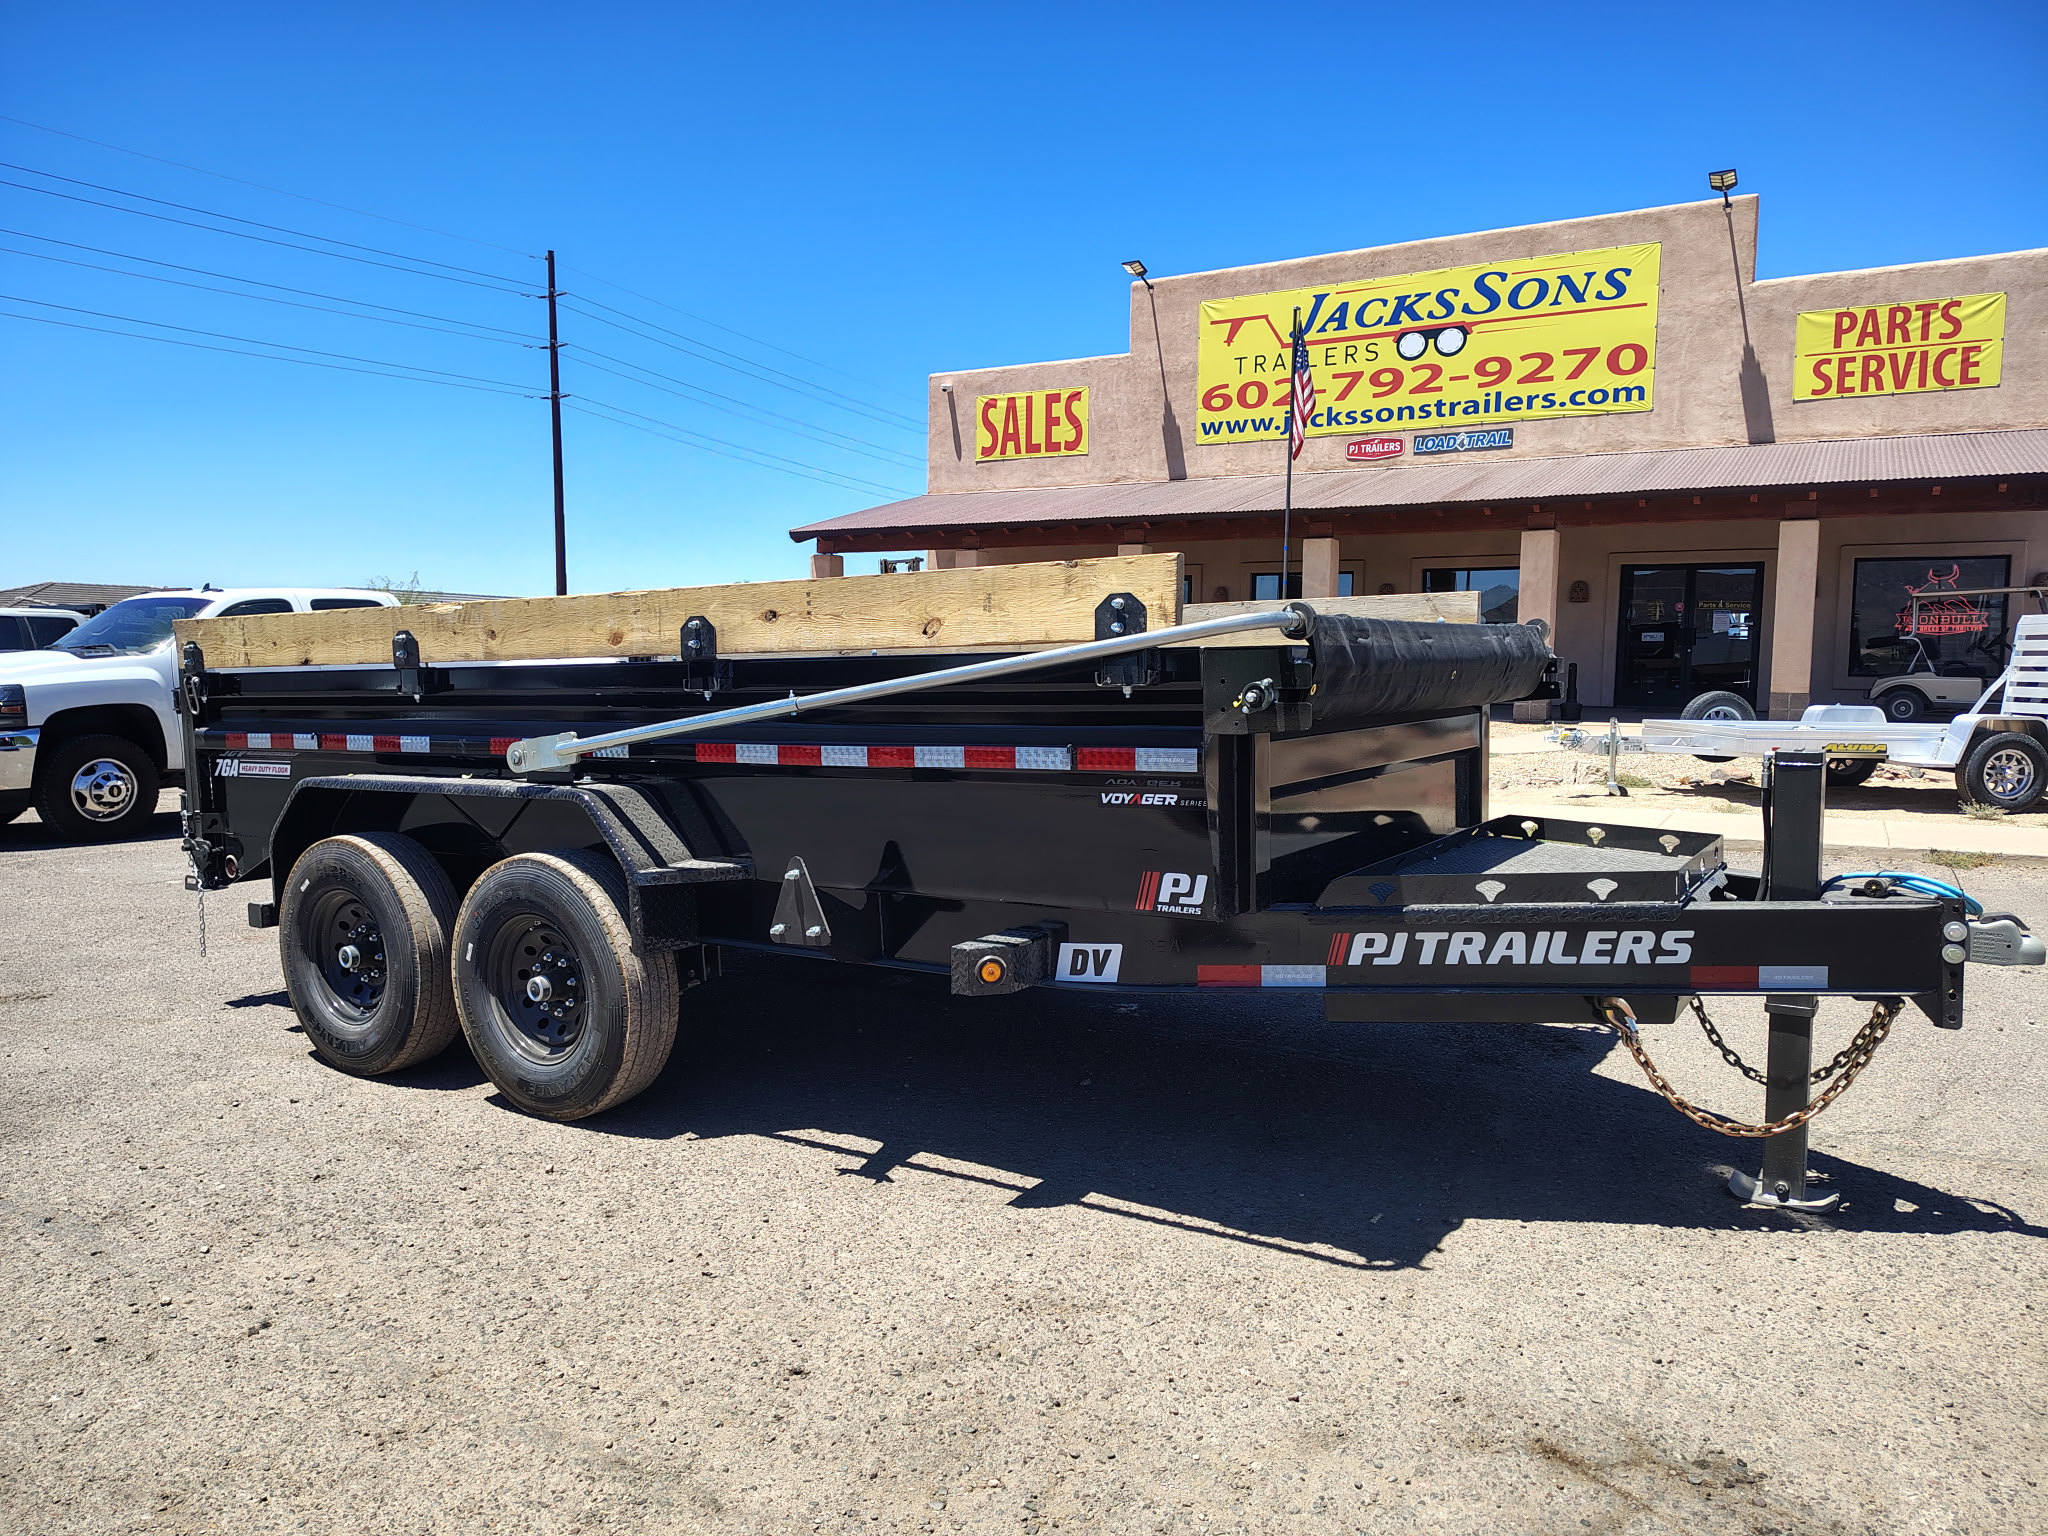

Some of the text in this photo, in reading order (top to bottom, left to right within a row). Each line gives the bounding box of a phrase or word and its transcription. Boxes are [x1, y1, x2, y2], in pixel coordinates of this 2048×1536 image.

[1833, 300, 1963, 349] PARTS
[1234, 343, 1379, 375] TRALERS
[1811, 346, 1982, 396] SERVICE
[1201, 343, 1648, 412] 602-792-9270
[981, 391, 1083, 457] SALES
[1201, 385, 1646, 436] www.jckssonstrailers.com
[1349, 441, 1401, 454] PJ TRAILERS
[1823, 743, 1887, 753] ALUMA
[214, 758, 239, 777] 7GA
[258, 765, 271, 773] DUTY
[271, 766, 288, 774] FLOOR
[1100, 792, 1207, 807] VOYAGER SERIES
[1158, 872, 1208, 905] PJ
[1157, 904, 1202, 915] TRAILERS
[1069, 949, 1112, 977] DV
[1348, 930, 1695, 966] PJ TRAILERS
